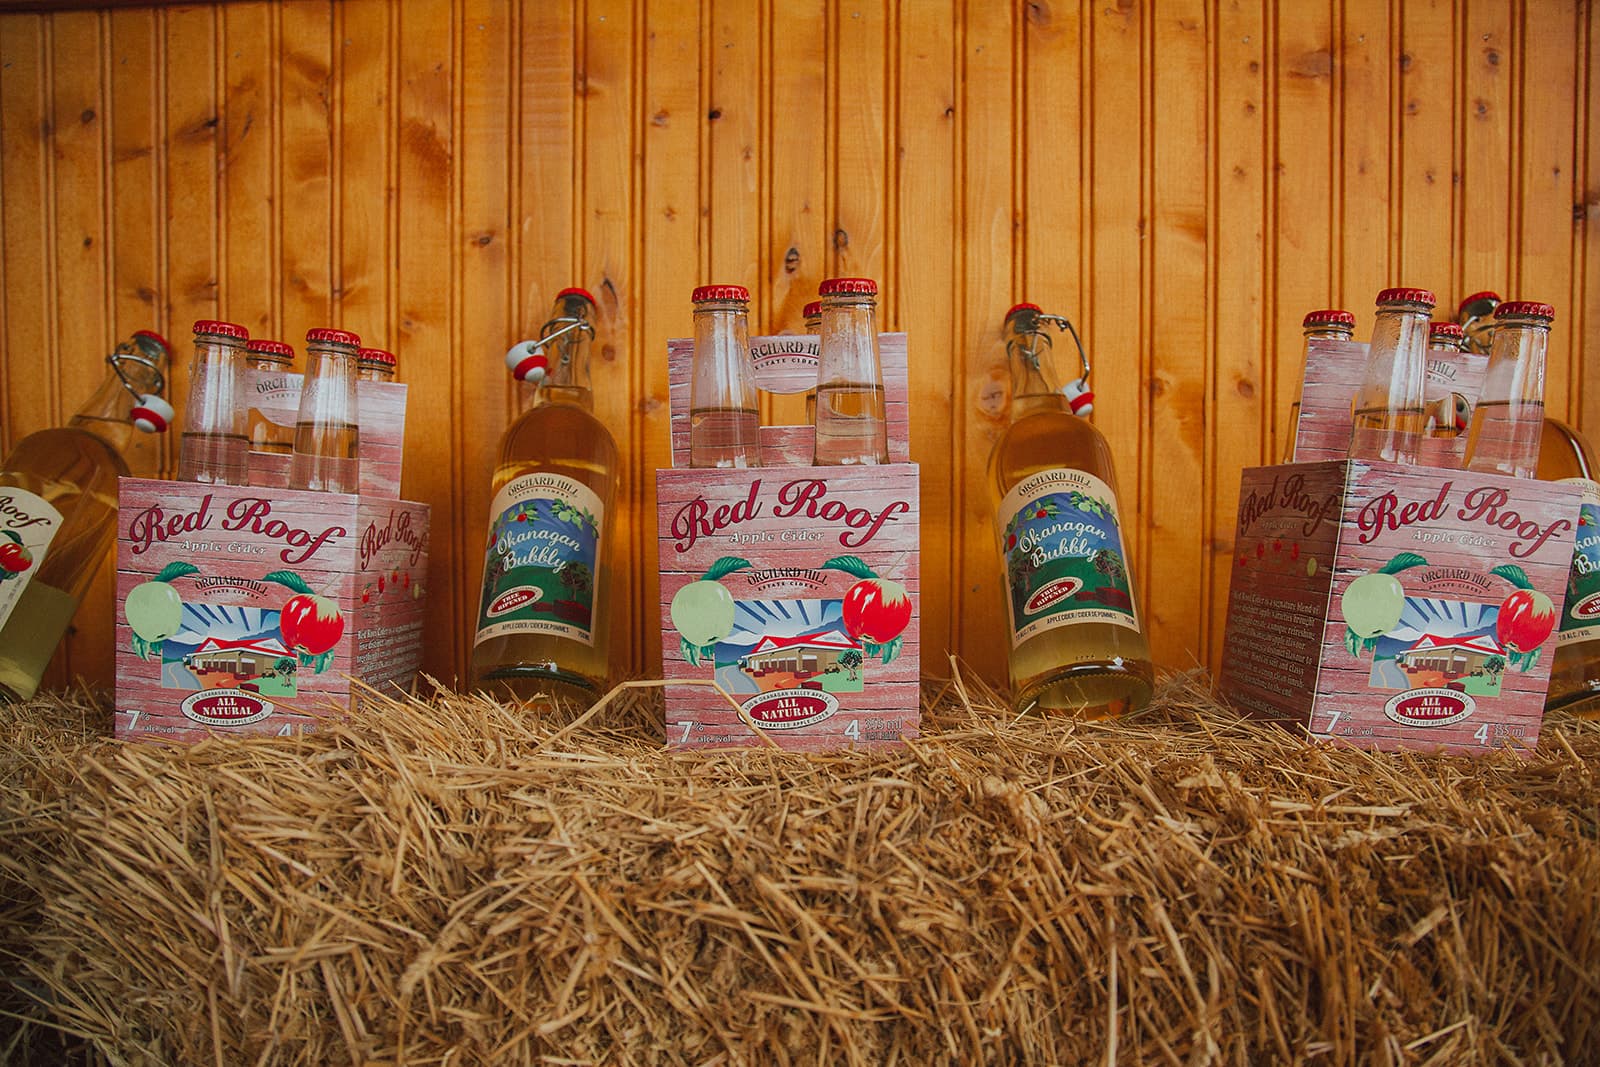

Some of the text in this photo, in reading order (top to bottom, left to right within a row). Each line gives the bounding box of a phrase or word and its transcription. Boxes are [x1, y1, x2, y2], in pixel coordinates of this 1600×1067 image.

[751, 342, 803, 360] RCHARD
[508, 477, 578, 496] ORCHARD HILL
[1018, 472, 1092, 496] ORCHARD HILL
[1241, 474, 1338, 536] Red Roof
[671, 479, 910, 553] Red Roof
[1358, 481, 1571, 558] Red Roof
[130, 494, 347, 564] Red Roof
[730, 530, 825, 544] Apple Cider
[1020, 522, 1107, 553] Okanagan
[180, 539, 266, 555] Apple Cider
[360, 510, 429, 571] Red Roof
[497, 528, 580, 555] Okanagan
[1412, 530, 1497, 548] Apple Cider
[503, 546, 566, 574] Bubbly
[1031, 538, 1098, 568] Bubbly
[747, 567, 828, 586] ORCHARD HILL
[1421, 568, 1494, 592] ORCHARD HILL
[195, 576, 268, 597] ORCHARD HILL
[1040, 584, 1060, 598] TREE
[497, 595, 528, 611] RIPENED
[502, 592, 520, 602] TREE
[1036, 587, 1069, 606] RIPENED
[202, 706, 253, 716] NATURAL
[217, 697, 237, 706] ALL
[777, 698, 798, 708] ALL
[1406, 706, 1454, 716] NATURAL
[1421, 697, 1440, 706] ALL
[761, 706, 816, 720] NATURAL
[752, 719, 790, 728] ANDCRAFTED
[844, 720, 860, 740] 4
[1474, 723, 1488, 744] 4
